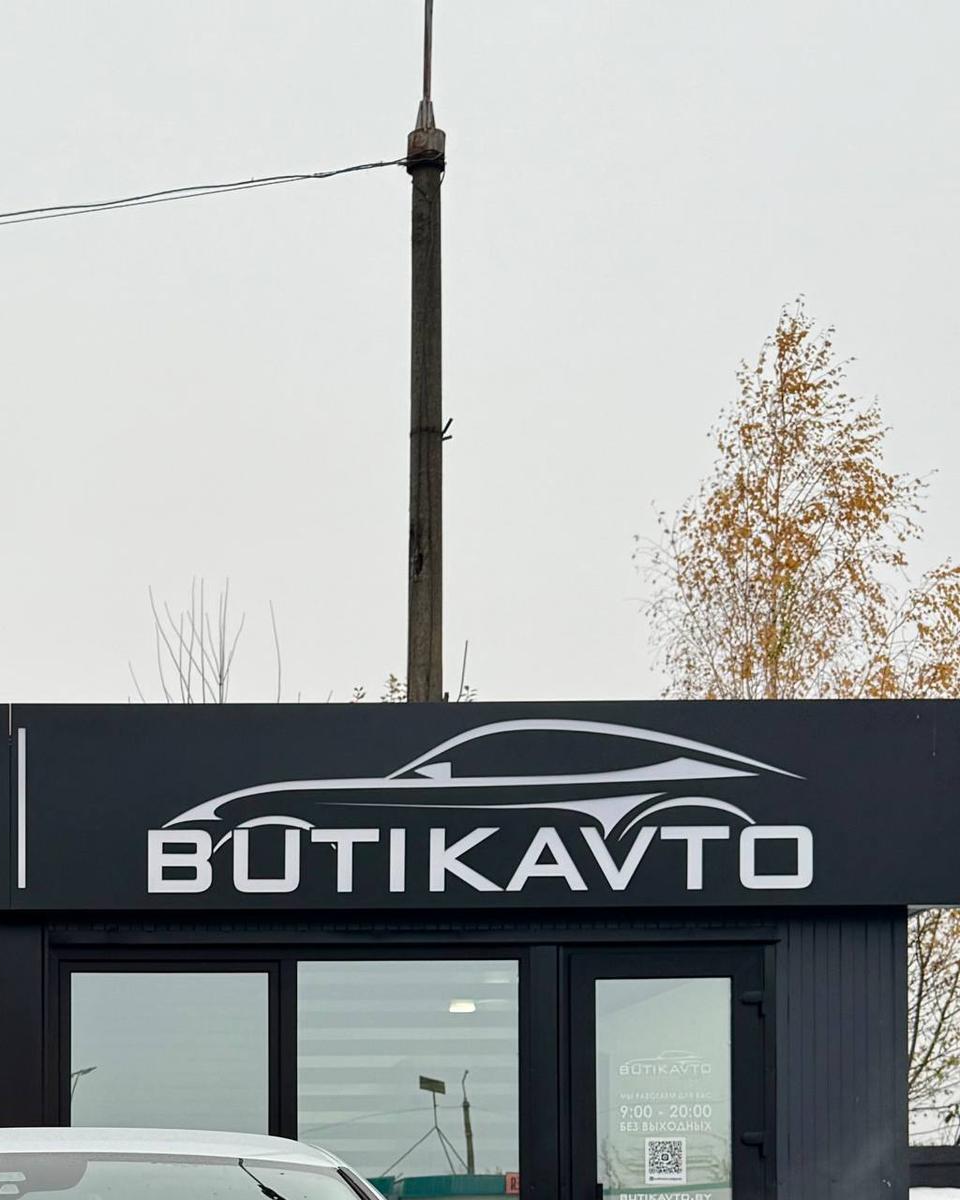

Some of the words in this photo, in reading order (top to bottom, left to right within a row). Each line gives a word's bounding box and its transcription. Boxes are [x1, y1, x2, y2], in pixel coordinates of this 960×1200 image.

[147, 825, 814, 893] BUTIKAVTO
[619, 1064, 712, 1075] BUTIKAVTO
[620, 1105, 653, 1118] 9:00
[669, 1105, 712, 1118] 20:00
[620, 1122, 638, 1132] БЕЗ
[642, 1122, 712, 1132] ВЫХОДНЫХ
